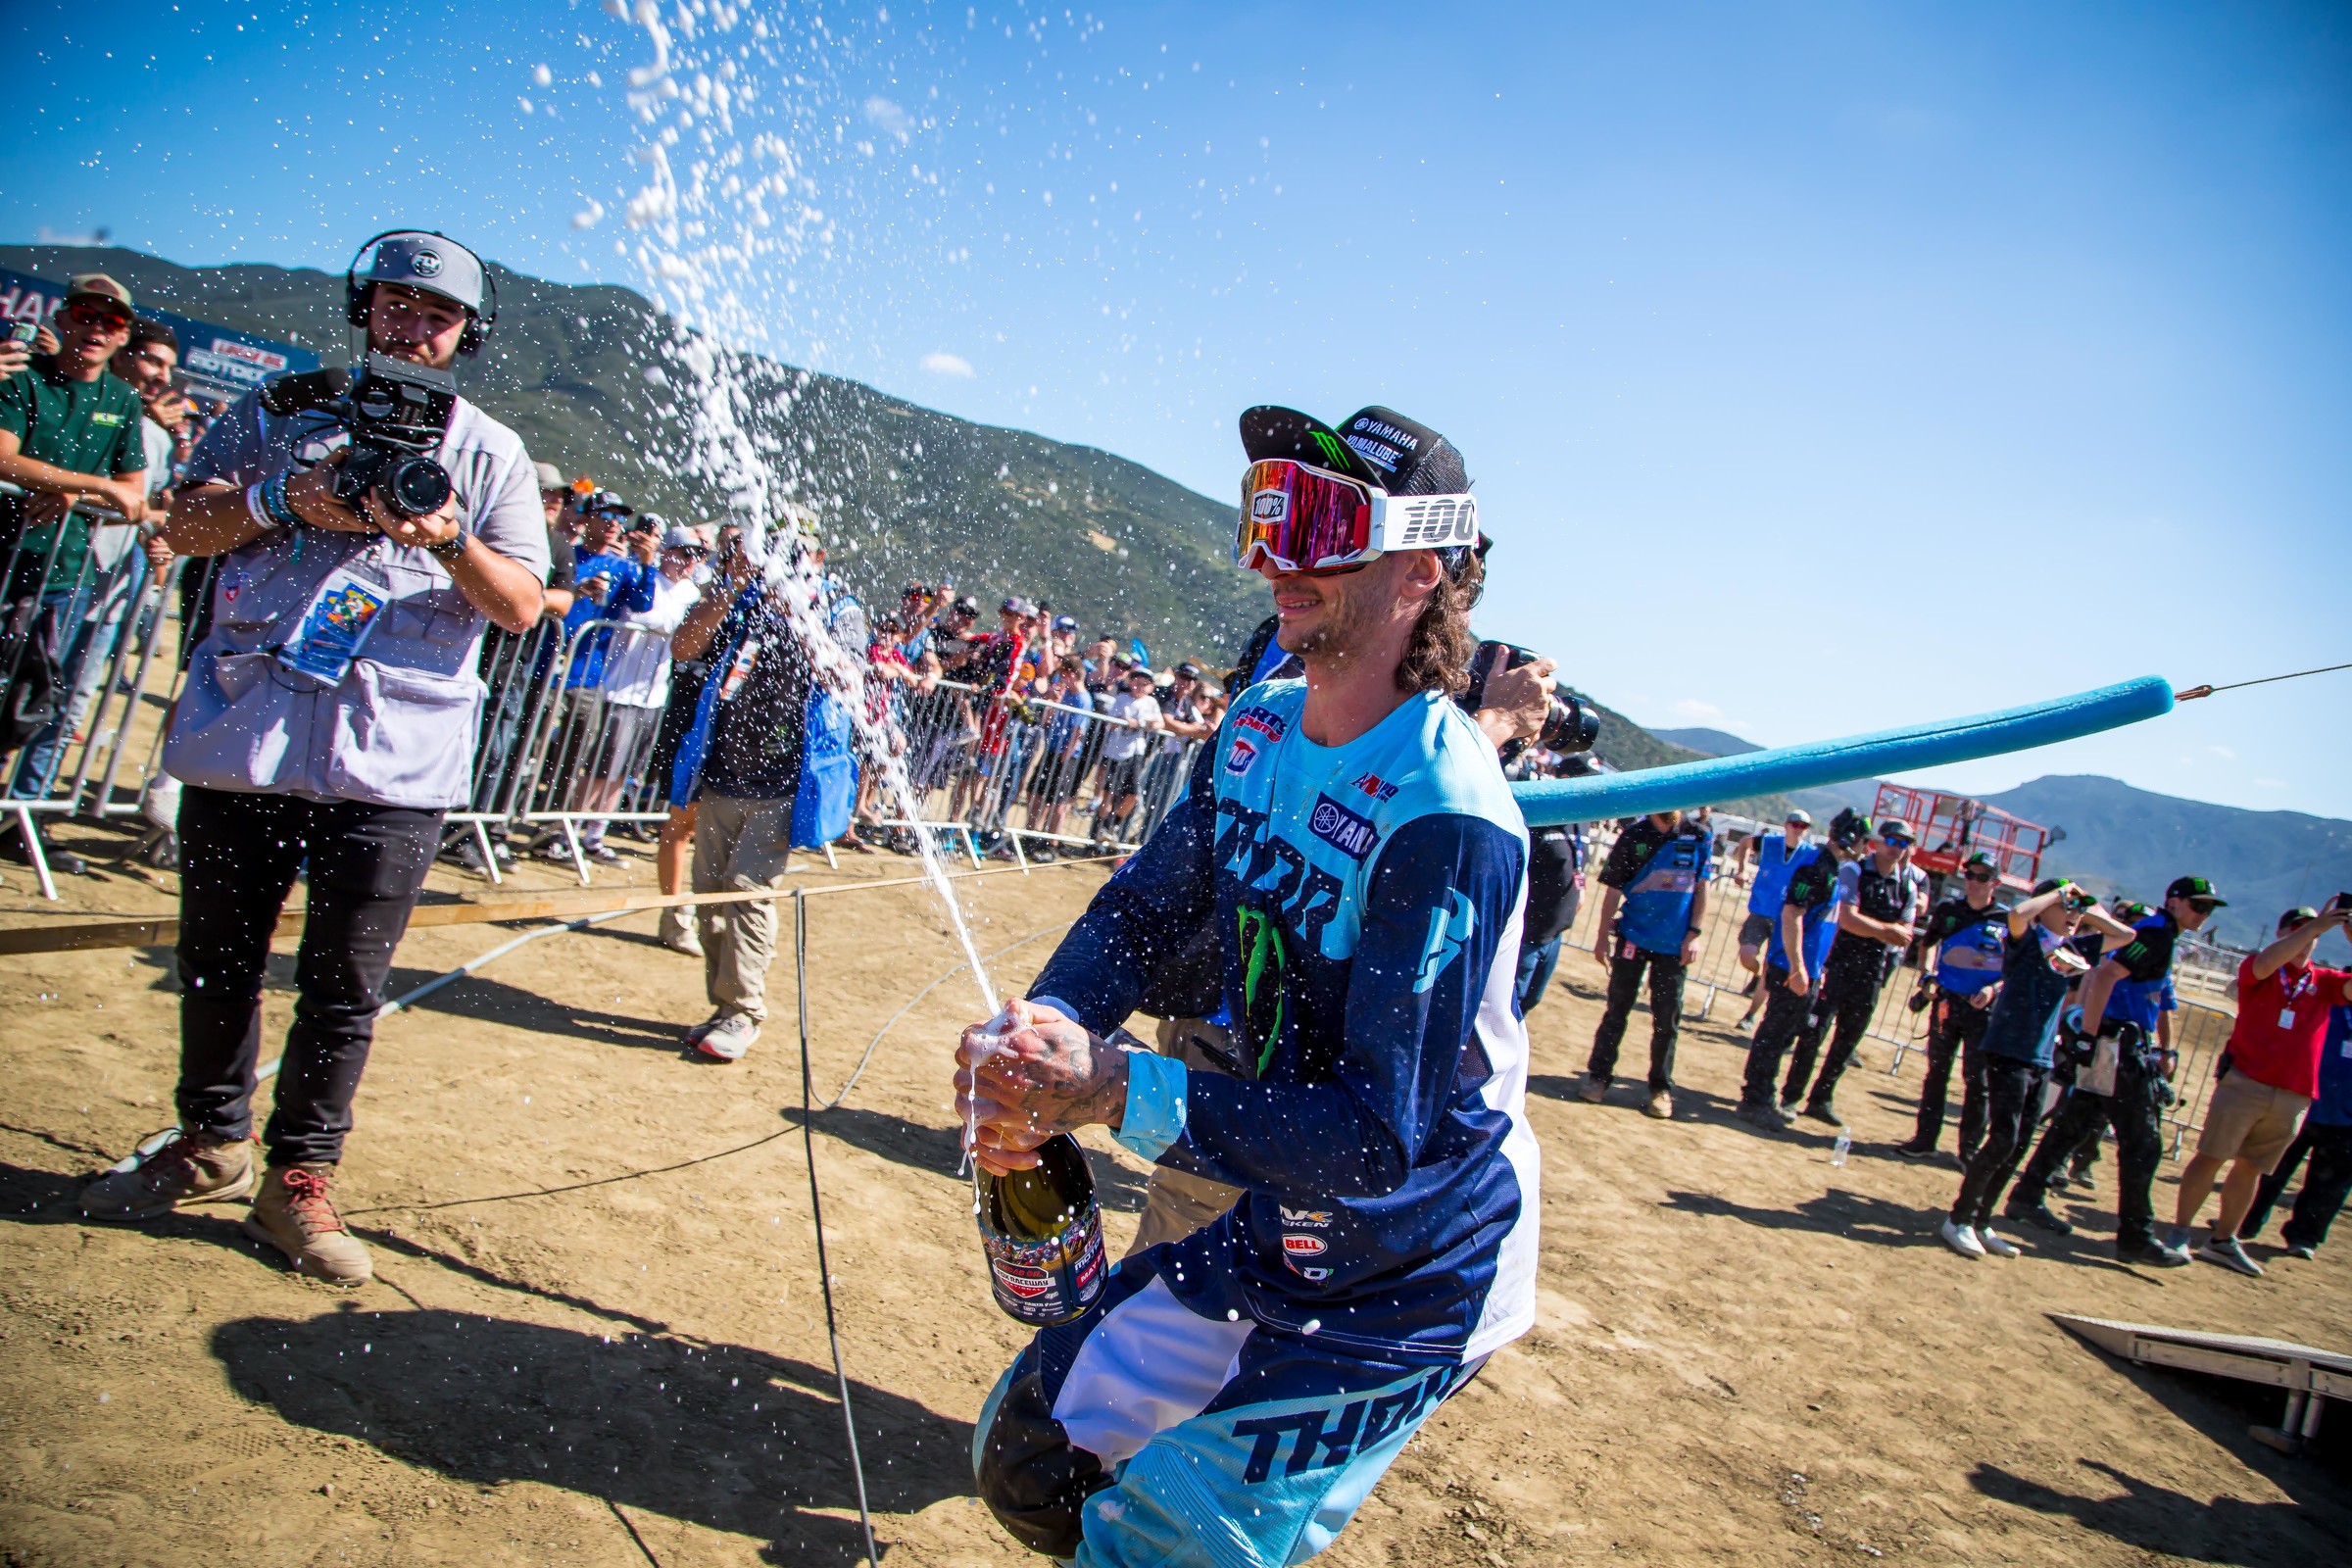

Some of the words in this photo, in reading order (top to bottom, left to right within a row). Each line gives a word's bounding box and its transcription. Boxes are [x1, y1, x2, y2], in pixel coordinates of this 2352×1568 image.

[1367, 419, 1419, 451] YAMAHA
[1254, 497, 1283, 515] 100%
[1285, 1239, 1322, 1250] BELL
[1009, 1275, 1049, 1287] RACEWAY
